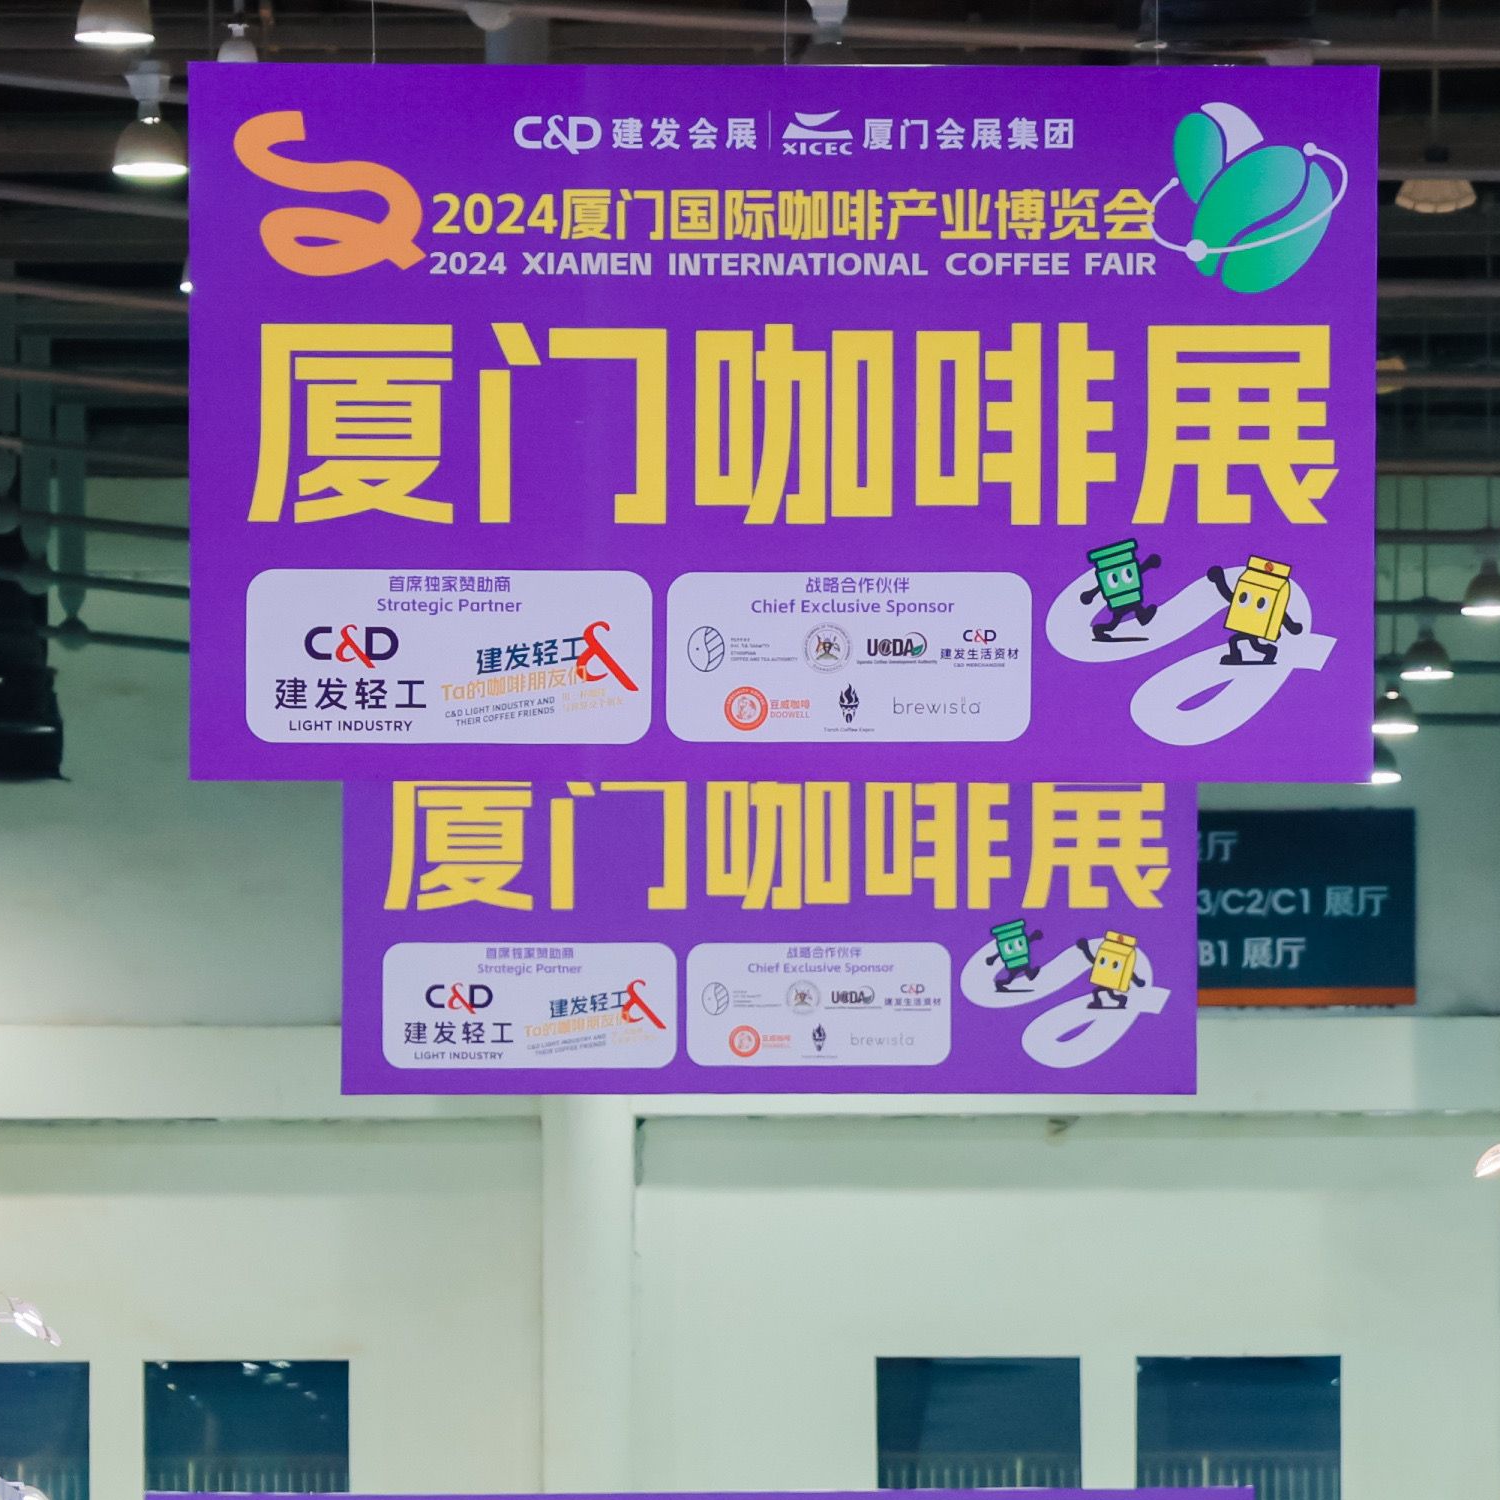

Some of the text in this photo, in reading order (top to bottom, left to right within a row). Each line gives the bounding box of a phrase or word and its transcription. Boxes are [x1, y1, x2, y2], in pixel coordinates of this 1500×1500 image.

[514, 115, 756, 154] C&D 建发会展
[782, 136, 853, 155] XICEC
[863, 117, 1073, 150] 厦门会展集团
[432, 188, 1159, 243] 2024厦门国际咖啡产业博览会
[429, 249, 1156, 277] 2024 XIAMEN INTERNATIONAL COFFEE FAIR
[247, 322, 1339, 525] 厦门咖啡展
[389, 576, 510, 592] 首席独家赞助商
[806, 577, 909, 593] 战略合作伙伴
[377, 598, 522, 615] Strategic Partner
[751, 599, 954, 616] Chief Exclusive Sponsor
[304, 625, 399, 668] C&D
[962, 628, 998, 646] C&D
[476, 635, 586, 676] 建发轻工
[939, 647, 1020, 661] 建发生活资材
[275, 677, 426, 710] 建发轻工
[440, 664, 589, 702] Ta的咖啡朋友们
[455, 706, 556, 727] THEIR COFFEE FRIENDS
[465, 704, 490, 716] LIGHT
[492, 700, 535, 713] INDUSTRY
[537, 696, 556, 706] AND
[290, 720, 412, 731] LIGHT INDUSTRY
[381, 780, 1174, 911] 厦门咖啡展
[1323, 885, 1389, 917] 展厅
[1242, 936, 1307, 969] 展厅
[478, 963, 582, 976] Strategic Partner
[748, 962, 894, 975] Chief Exclusive Sponsor
[426, 984, 493, 1014] C&D
[549, 990, 629, 1019] 建发轻工
[405, 1021, 513, 1044] 建发轻工
[414, 1051, 503, 1060] LIGHT INDUSTRY
